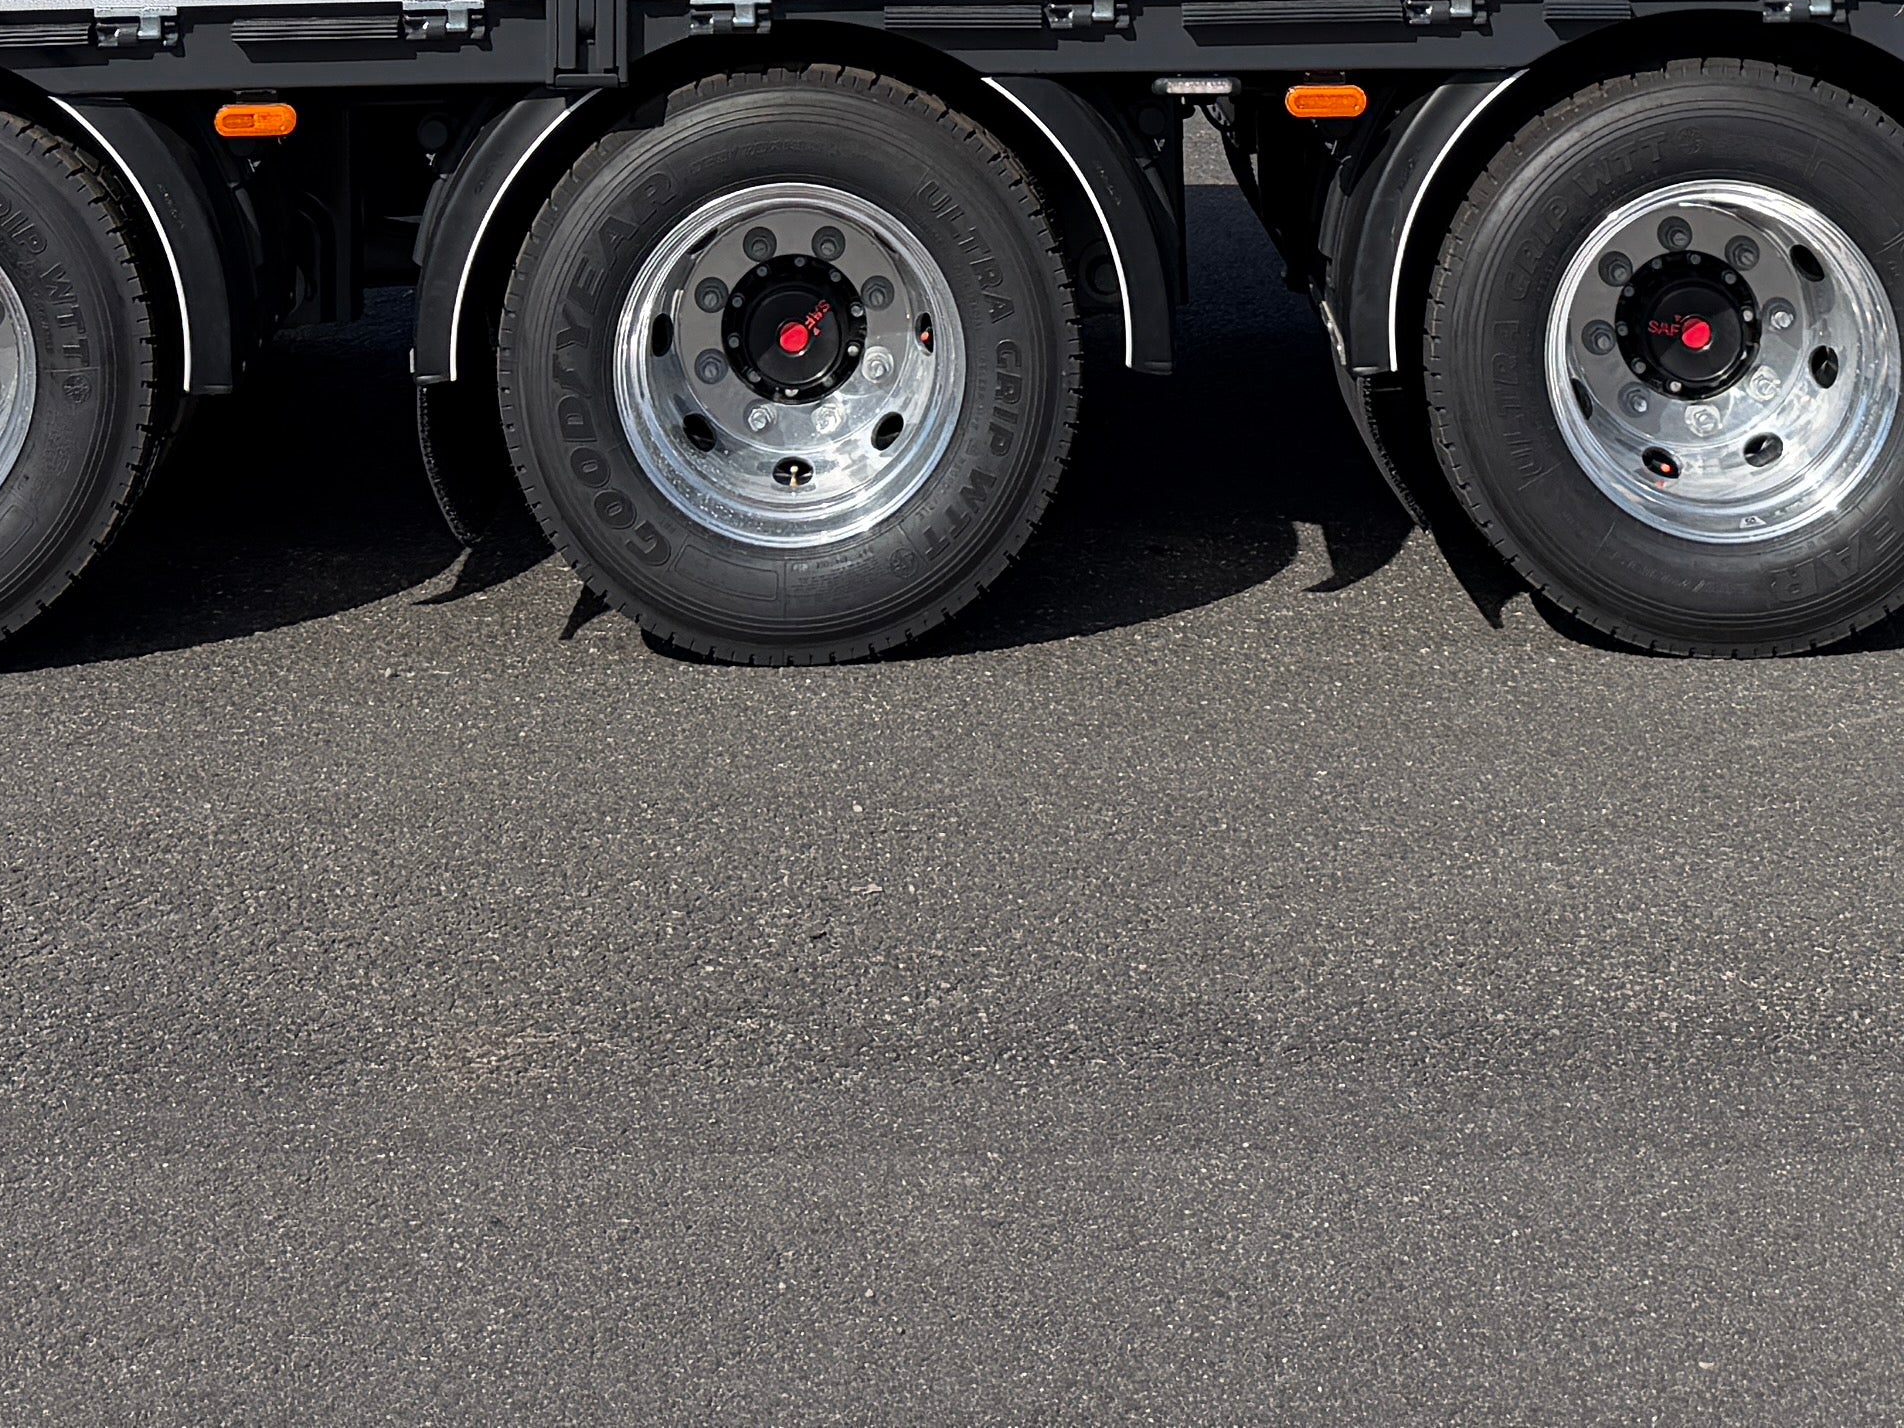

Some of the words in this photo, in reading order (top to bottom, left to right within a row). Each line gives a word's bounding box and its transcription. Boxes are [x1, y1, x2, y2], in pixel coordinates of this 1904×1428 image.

[1648, 320, 1681, 336] SAF
[990, 339, 1023, 457] GRIP
[922, 468, 997, 561] WTT
